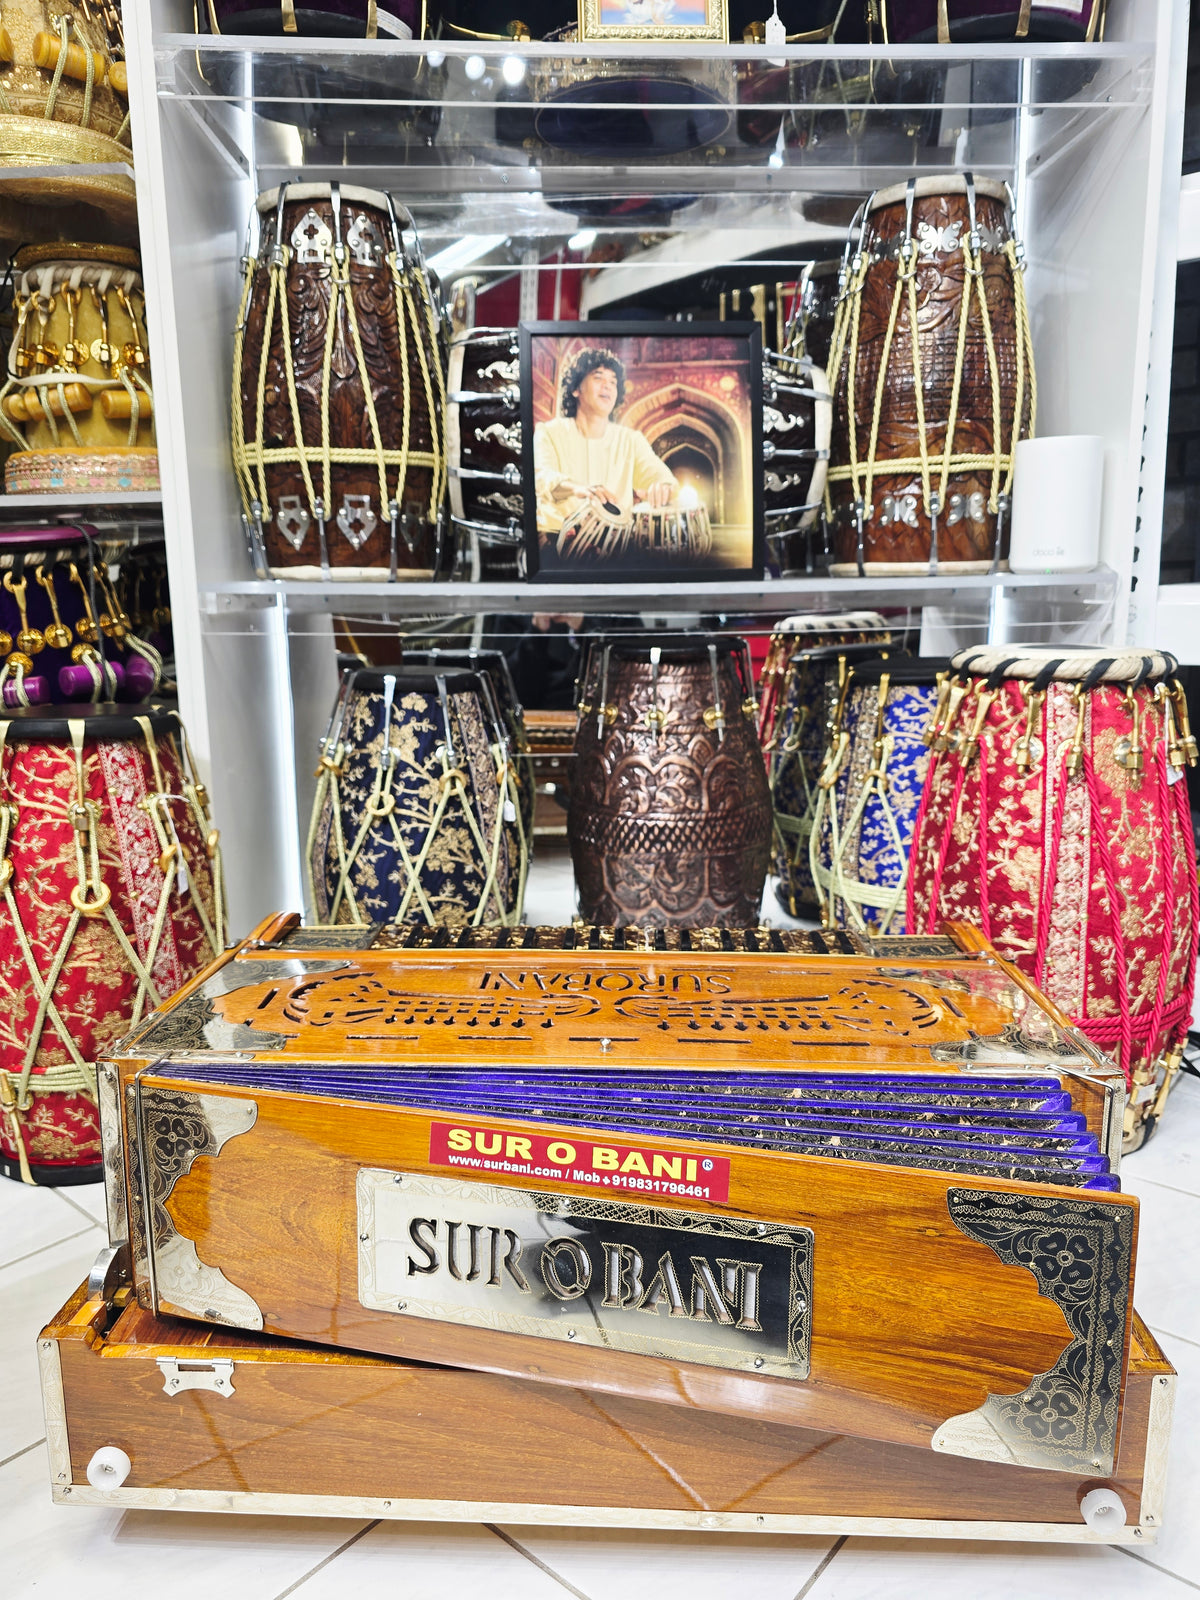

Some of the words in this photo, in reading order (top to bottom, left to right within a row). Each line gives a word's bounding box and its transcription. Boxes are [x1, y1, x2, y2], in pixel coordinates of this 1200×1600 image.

[447, 1129, 533, 1160] SUR
[546, 1141, 577, 1165] O
[405, 1216, 532, 1295] SUR
[540, 1235, 593, 1300] O
[600, 1240, 764, 1332] BANI
